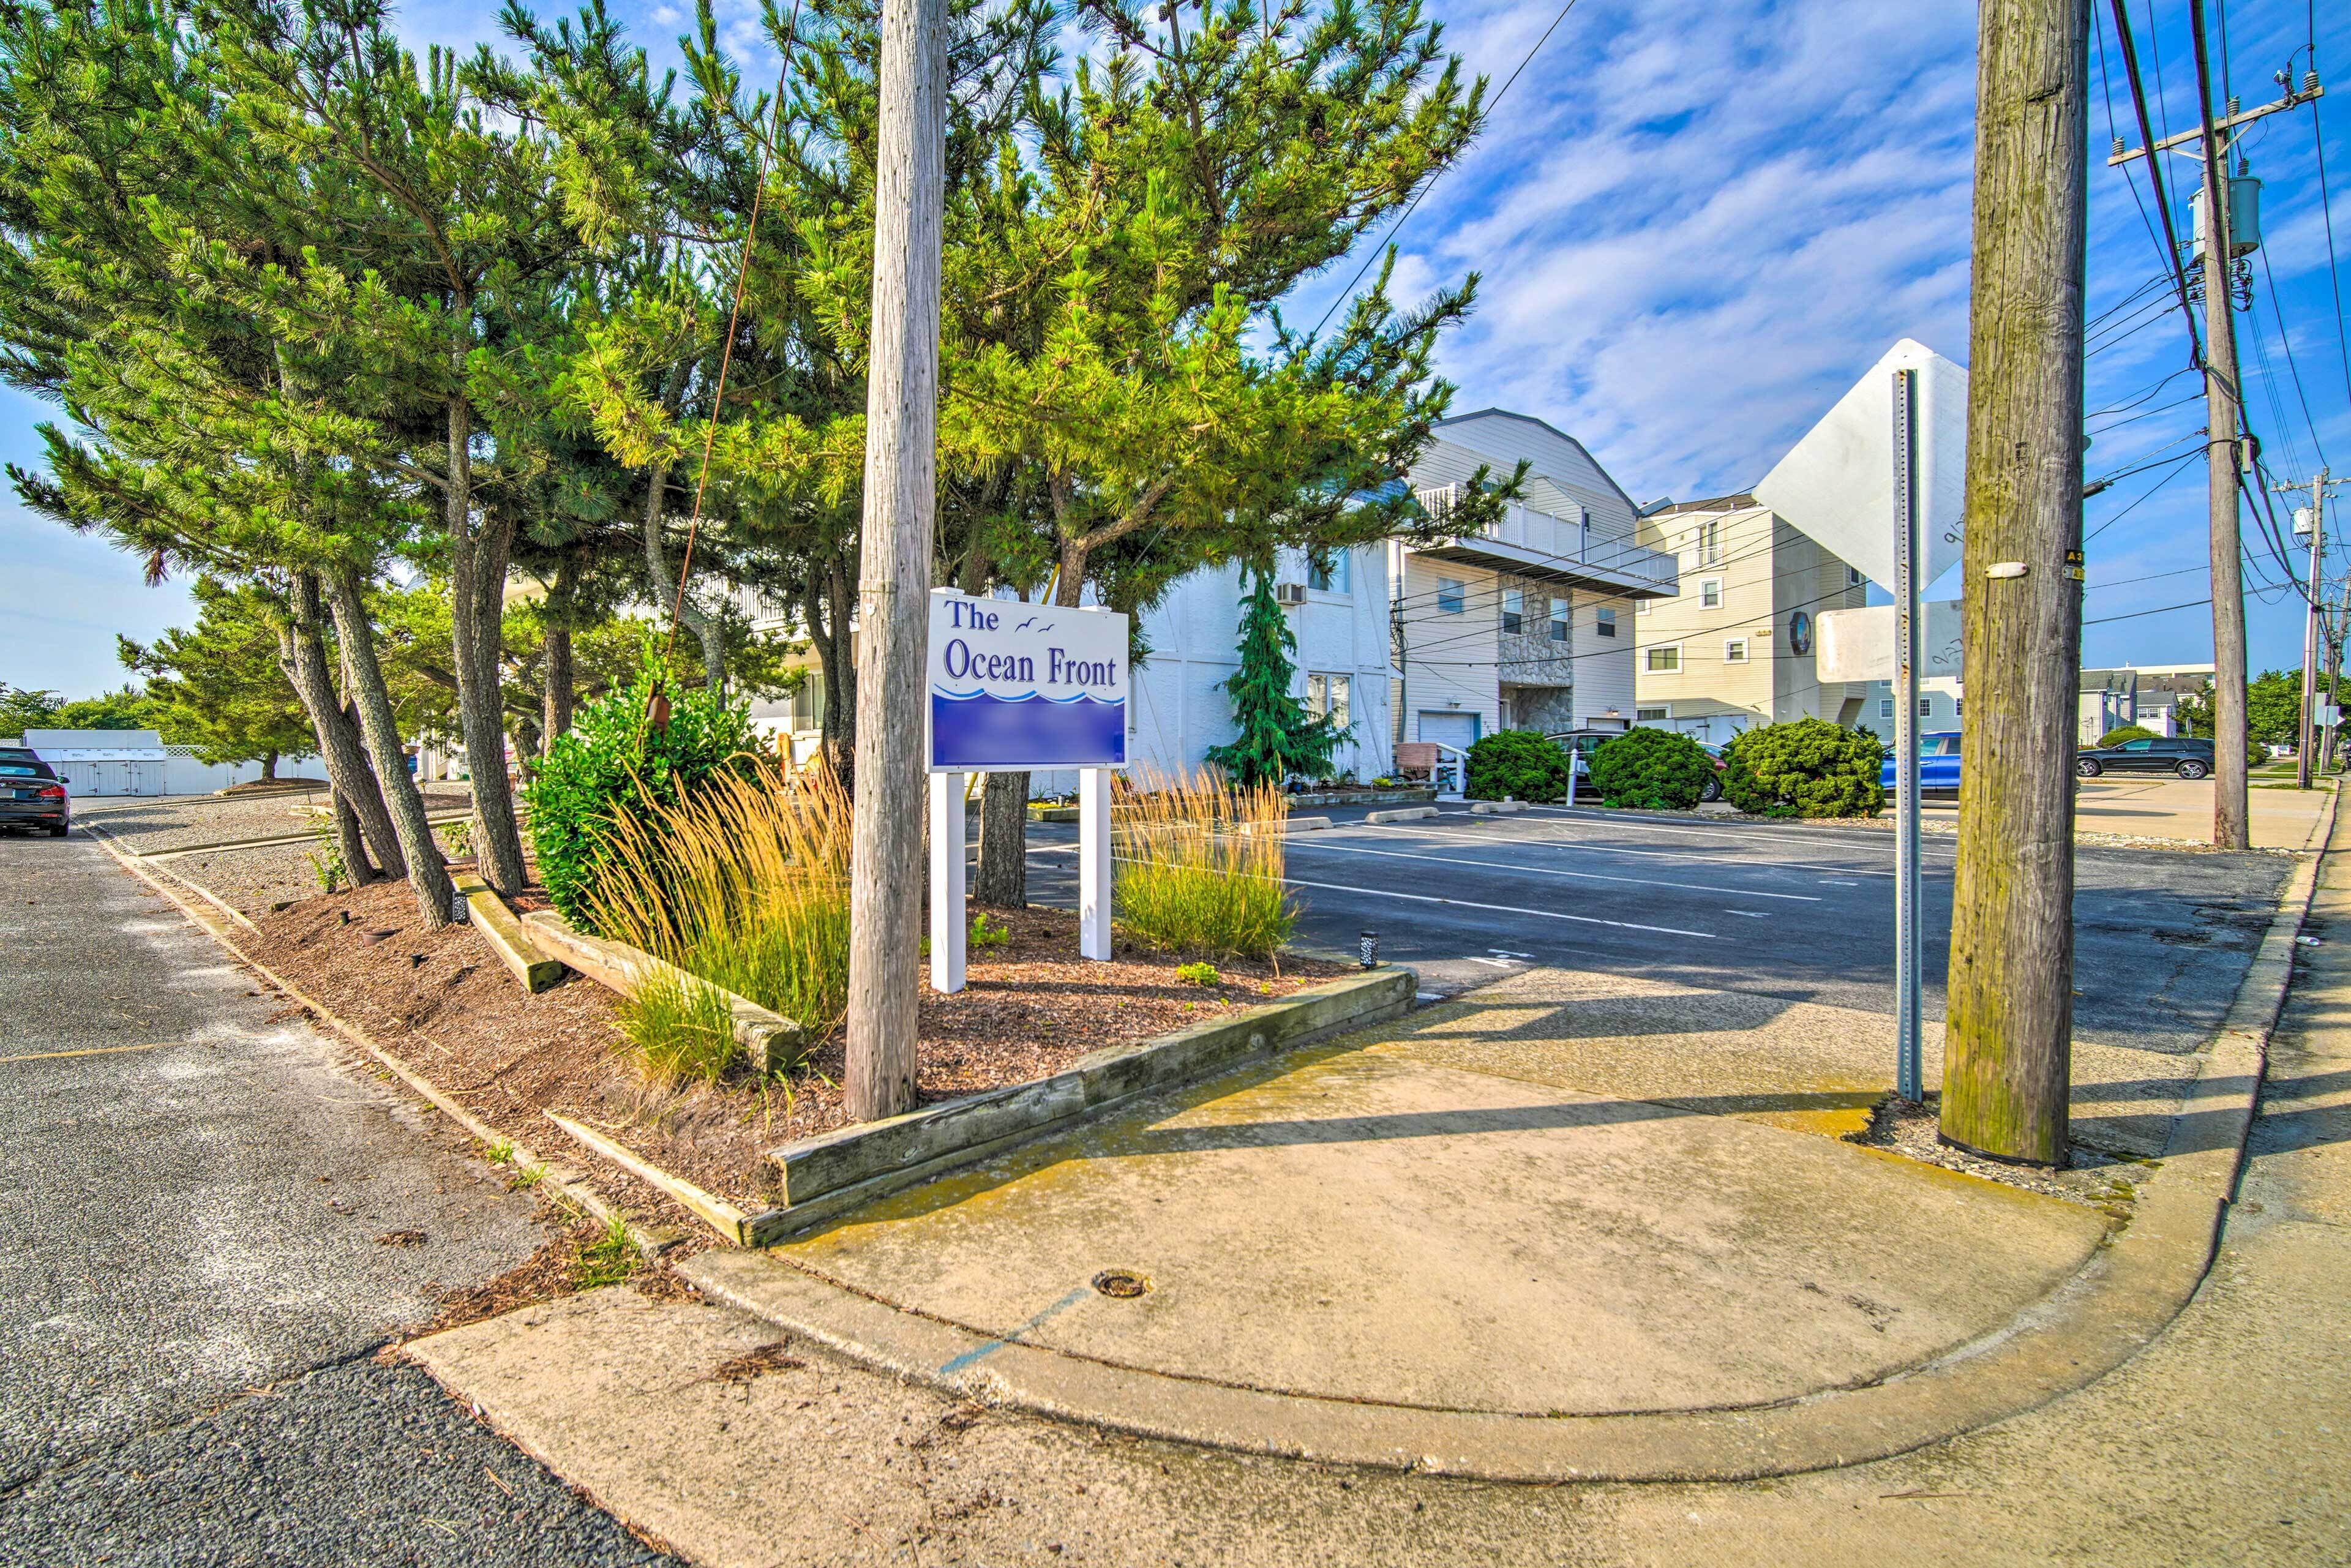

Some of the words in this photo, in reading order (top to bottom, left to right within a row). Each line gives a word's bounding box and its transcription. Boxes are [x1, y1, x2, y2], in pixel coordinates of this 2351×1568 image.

[943, 600, 999, 631] The
[943, 639, 1035, 682] Ocean
[1047, 647, 1117, 686] Front
